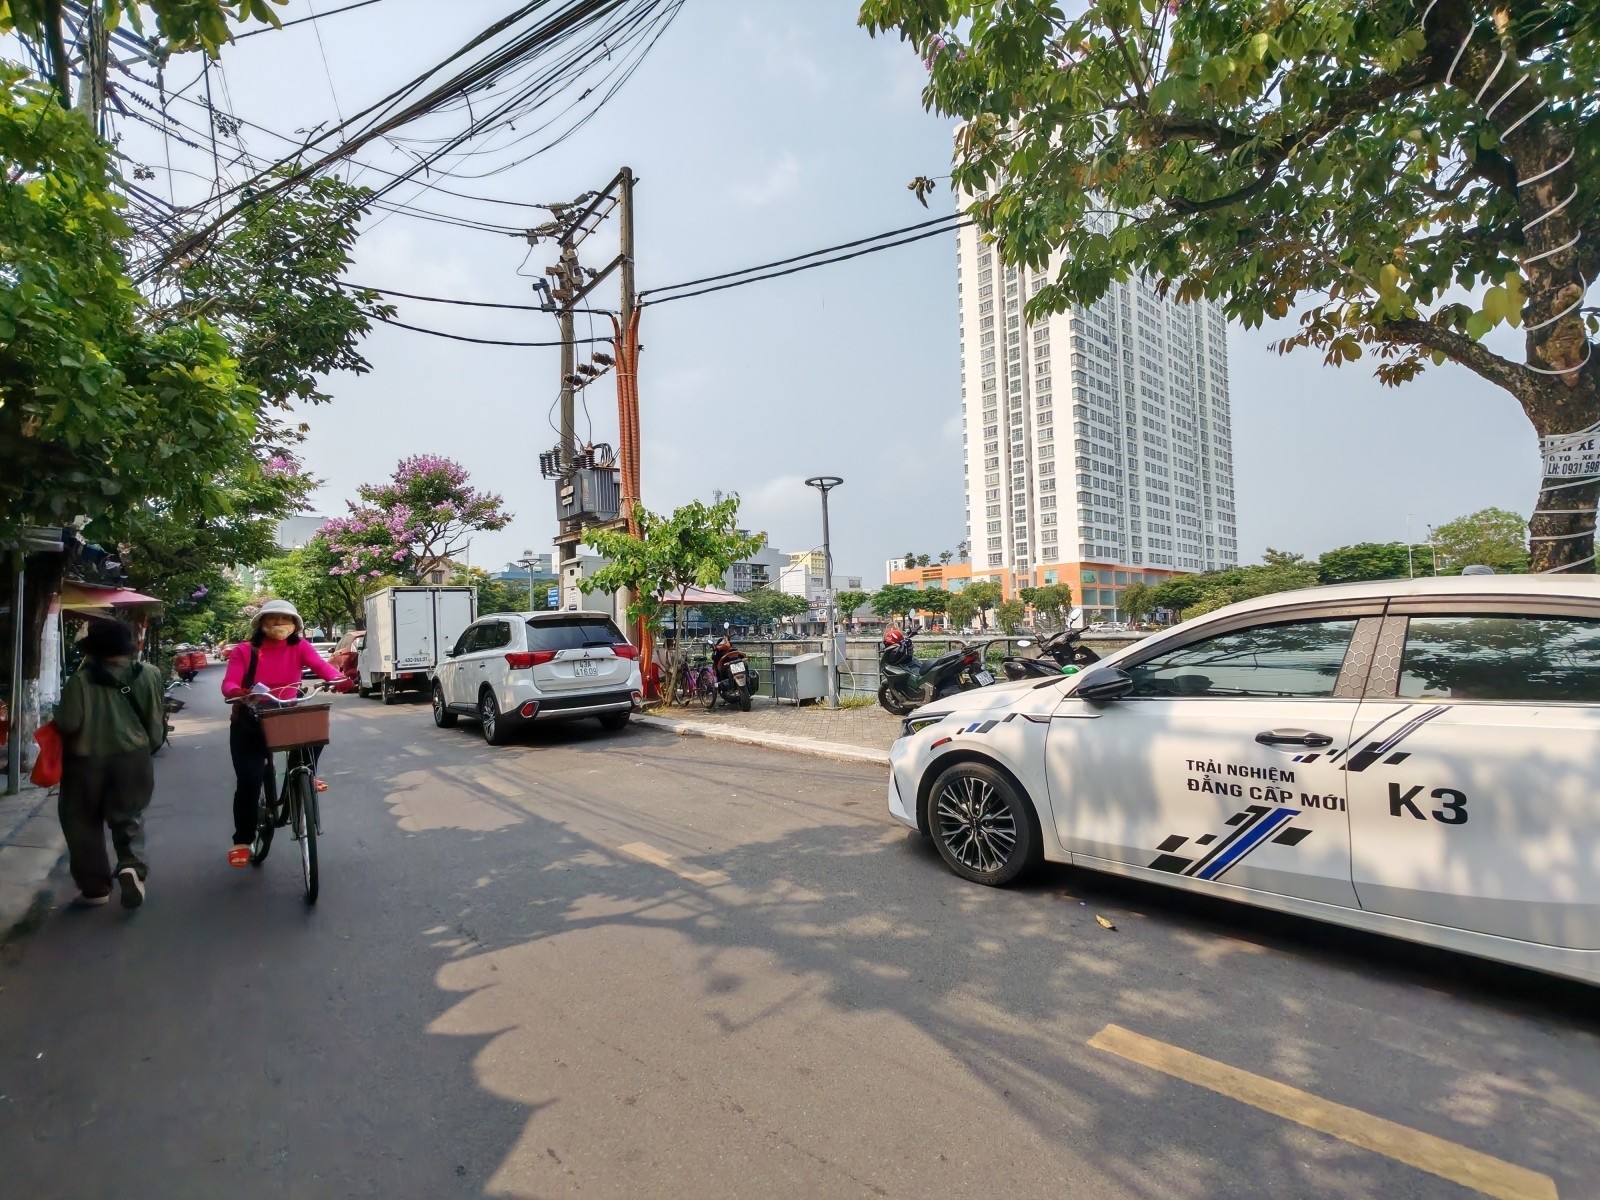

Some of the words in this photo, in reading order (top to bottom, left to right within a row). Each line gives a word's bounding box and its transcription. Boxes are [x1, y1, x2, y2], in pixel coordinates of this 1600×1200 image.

[1547, 463, 1560, 475] LH:
[579, 660, 592, 668] 43A
[1186, 759, 1222, 774] TRẢI
[1227, 764, 1295, 783] NGHIỆM
[1187, 775, 1243, 797] ĐẲNG
[1249, 785, 1293, 804] CẤP
[1301, 793, 1346, 812] MỚI
[1388, 782, 1469, 825] K3
